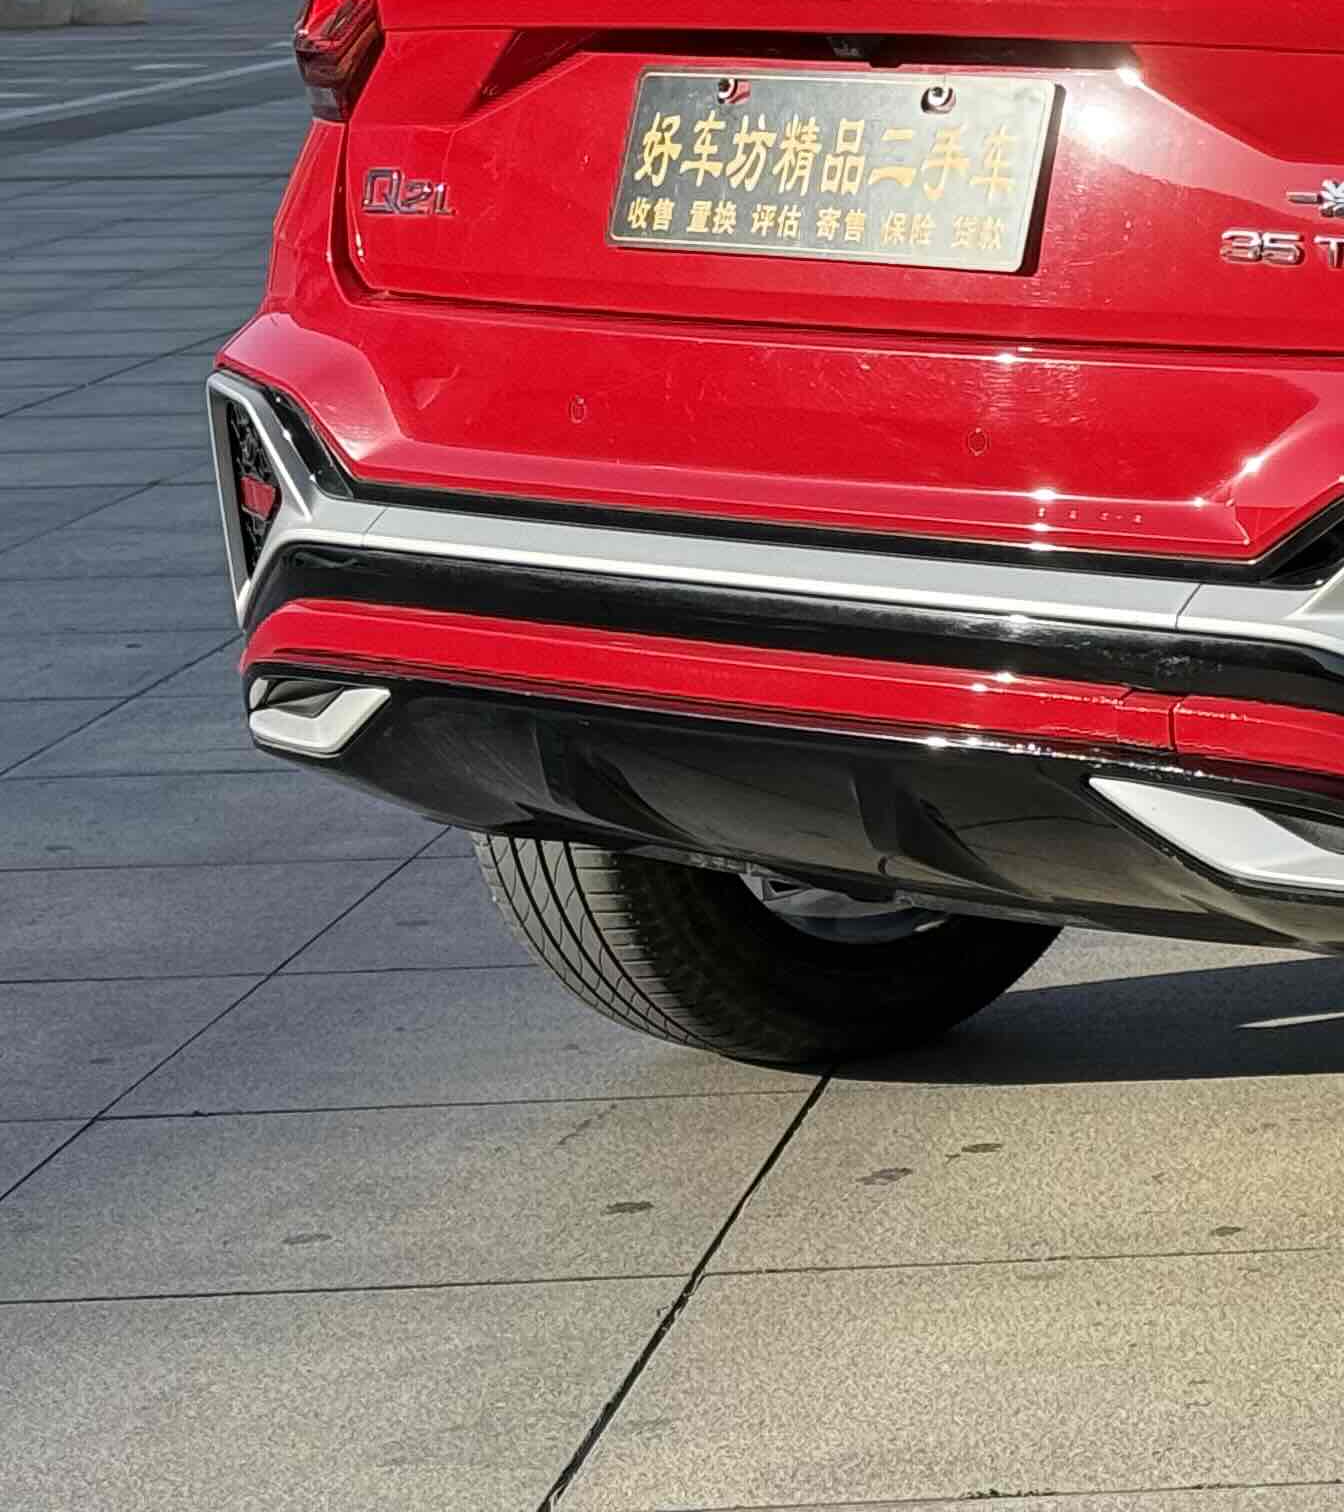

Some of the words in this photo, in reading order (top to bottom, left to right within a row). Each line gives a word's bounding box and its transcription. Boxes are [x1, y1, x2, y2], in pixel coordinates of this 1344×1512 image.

[634, 111, 1017, 201] 好车坊精品二手车
[627, 195, 675, 232] 收售
[686, 199, 738, 235] 置换
[751, 202, 801, 240] 评估
[880, 209, 937, 248] 保险
[1219, 228, 1304, 265] 35
